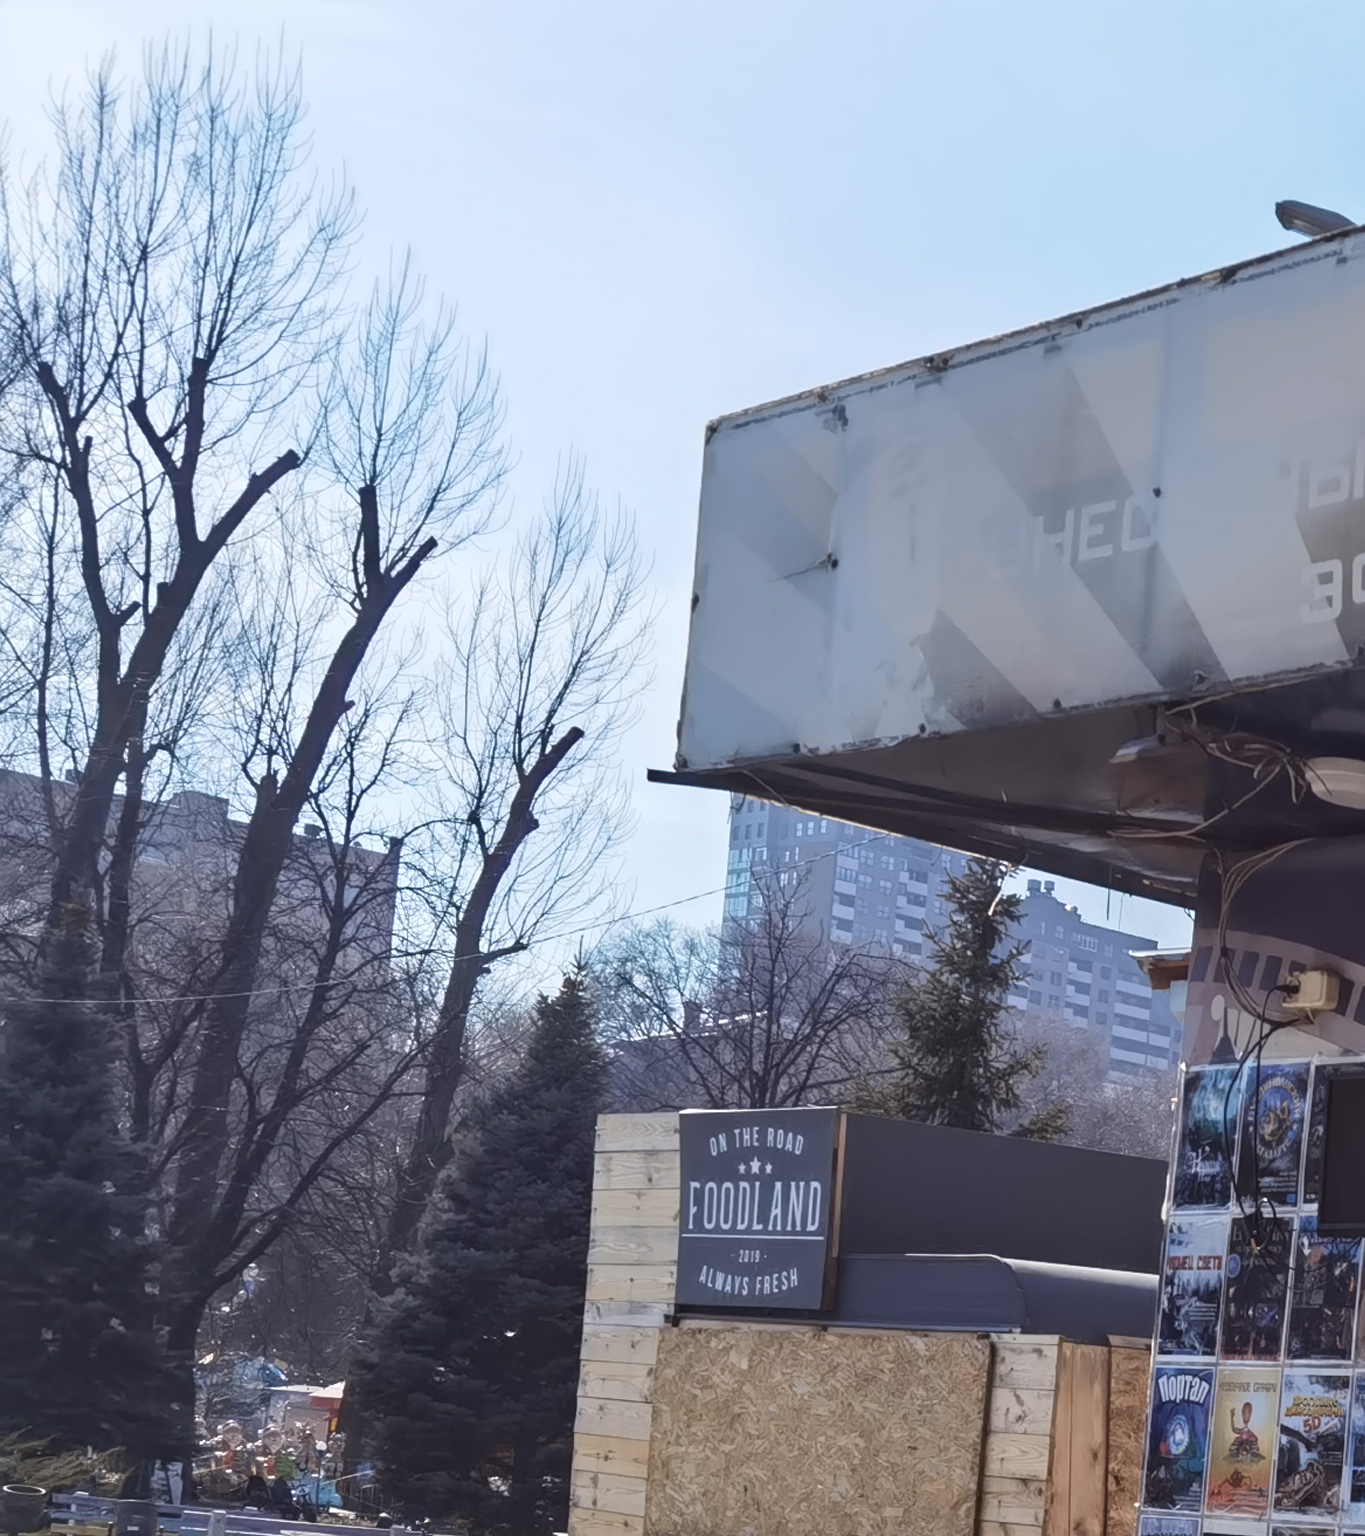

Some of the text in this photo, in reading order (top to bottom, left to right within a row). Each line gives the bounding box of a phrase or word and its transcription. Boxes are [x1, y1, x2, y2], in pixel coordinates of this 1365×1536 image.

[709, 1127, 804, 1156] ON THE ROAD
[688, 1181, 822, 1232] FOODLAND
[738, 1250, 760, 1262] 2019
[699, 1265, 798, 1296] ALWAYS FRESH
